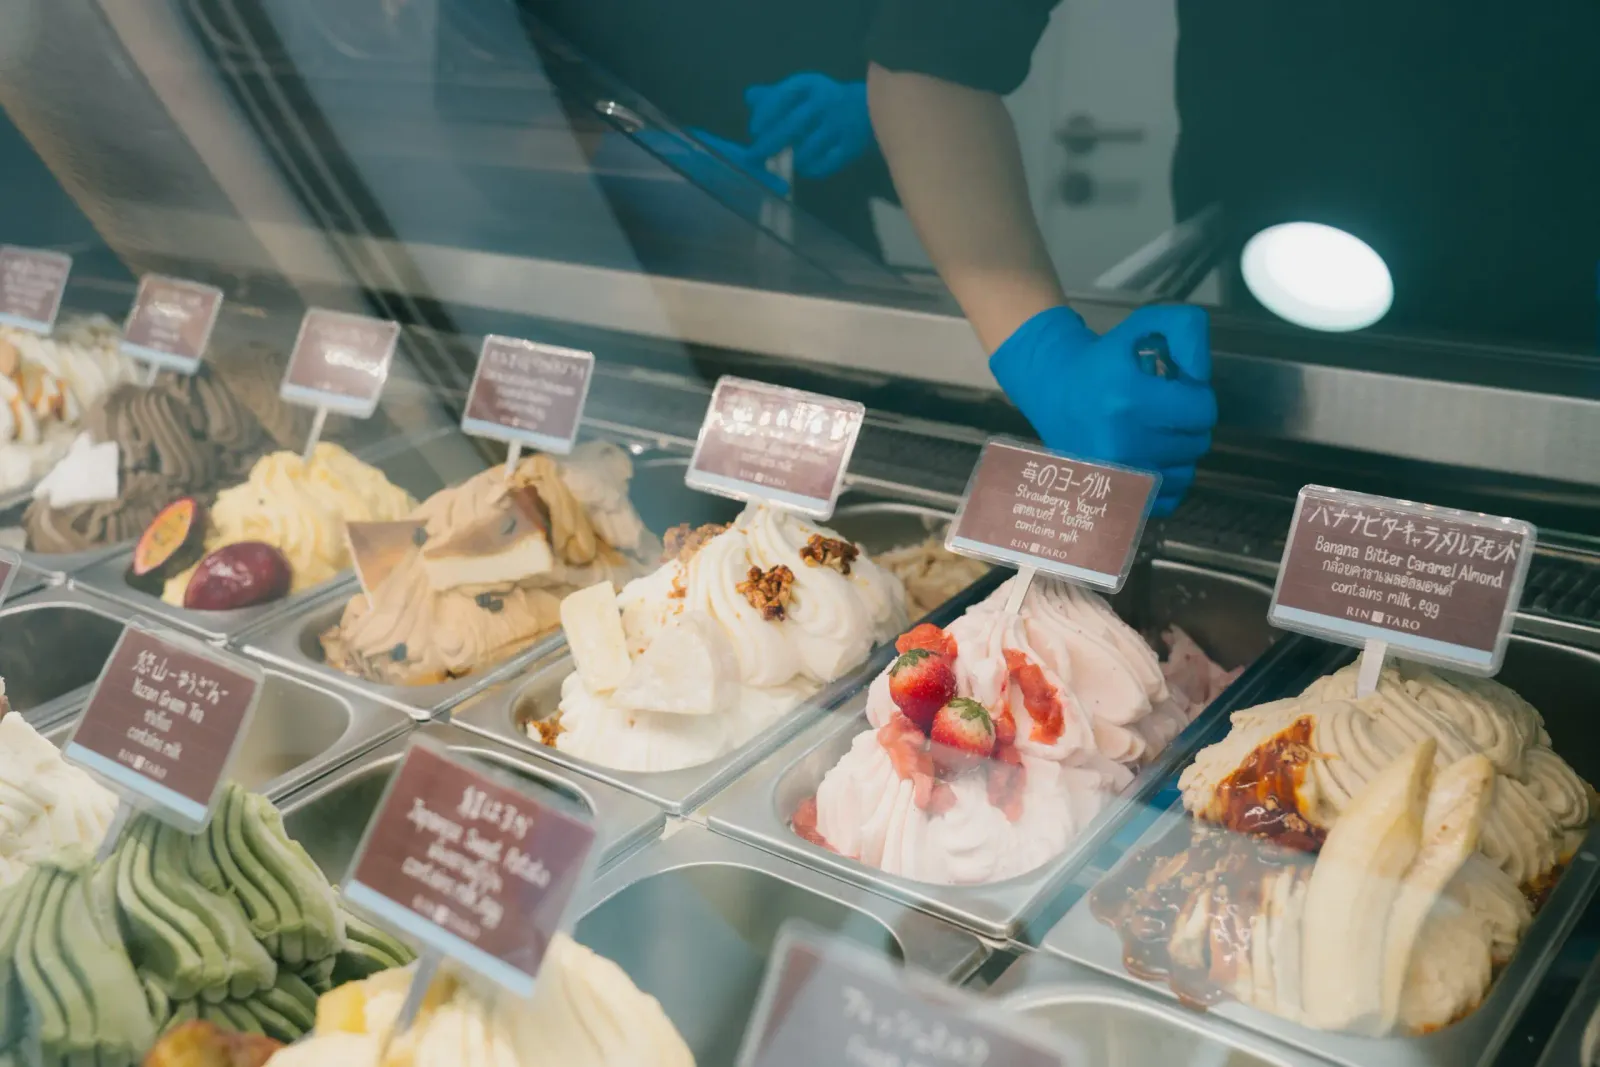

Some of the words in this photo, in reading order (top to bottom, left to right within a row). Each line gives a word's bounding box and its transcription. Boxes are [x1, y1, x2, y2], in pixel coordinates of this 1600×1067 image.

[1021, 460, 1111, 500] 苺のヨーグルト
[1015, 483, 1070, 510] Strawberry
[1076, 495, 1107, 517] Yogurt
[1015, 520, 1055, 538] contains
[1059, 529, 1079, 543] milk
[1010, 538, 1029, 550] RIN
[1040, 546, 1067, 559] TARO
[1315, 535, 1359, 559] Banana
[1364, 545, 1401, 567] Bitter
[1407, 556, 1457, 578] Caramel
[1458, 566, 1504, 588] Almond
[1331, 581, 1383, 601] contains
[1346, 606, 1370, 619] RIN
[1386, 615, 1421, 631] TARO
